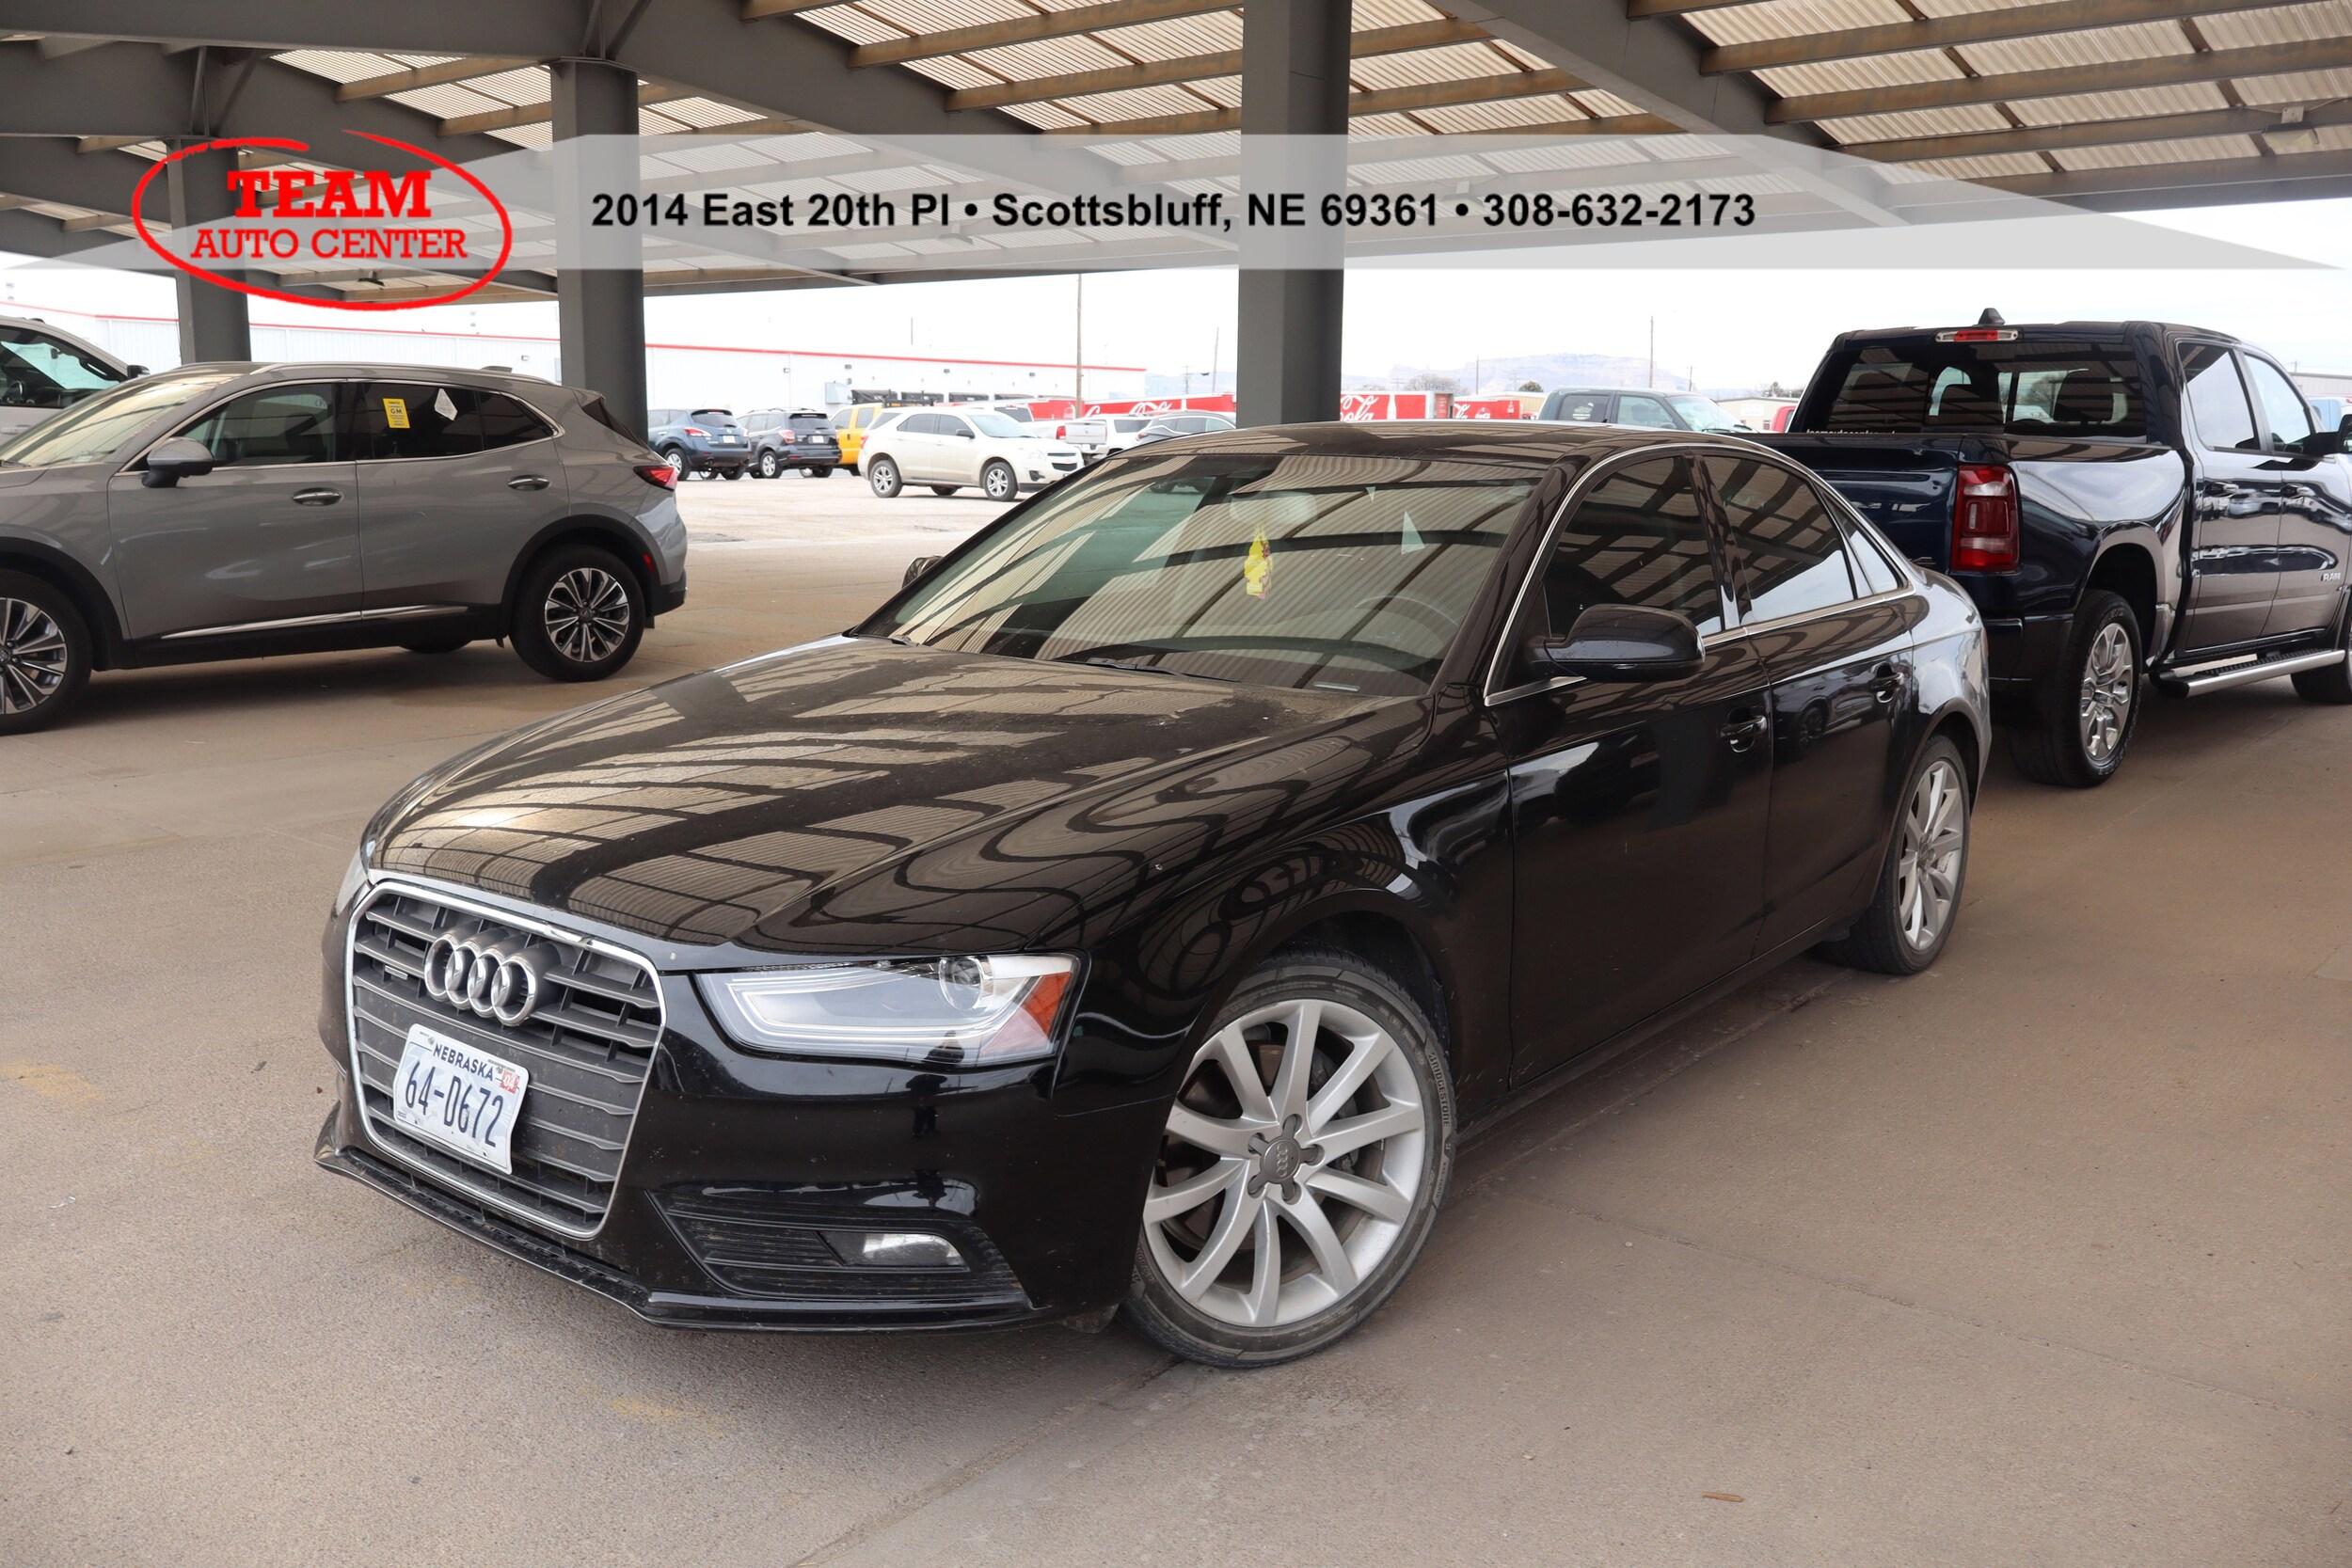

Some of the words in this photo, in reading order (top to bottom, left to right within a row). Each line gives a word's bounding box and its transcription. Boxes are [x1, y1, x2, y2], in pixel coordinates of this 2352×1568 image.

[433, 1042, 494, 1081] NEBRASKA
[1428, 1052, 1450, 1128] BRIDGESTONE
[405, 1061, 504, 1148] 64-D672
